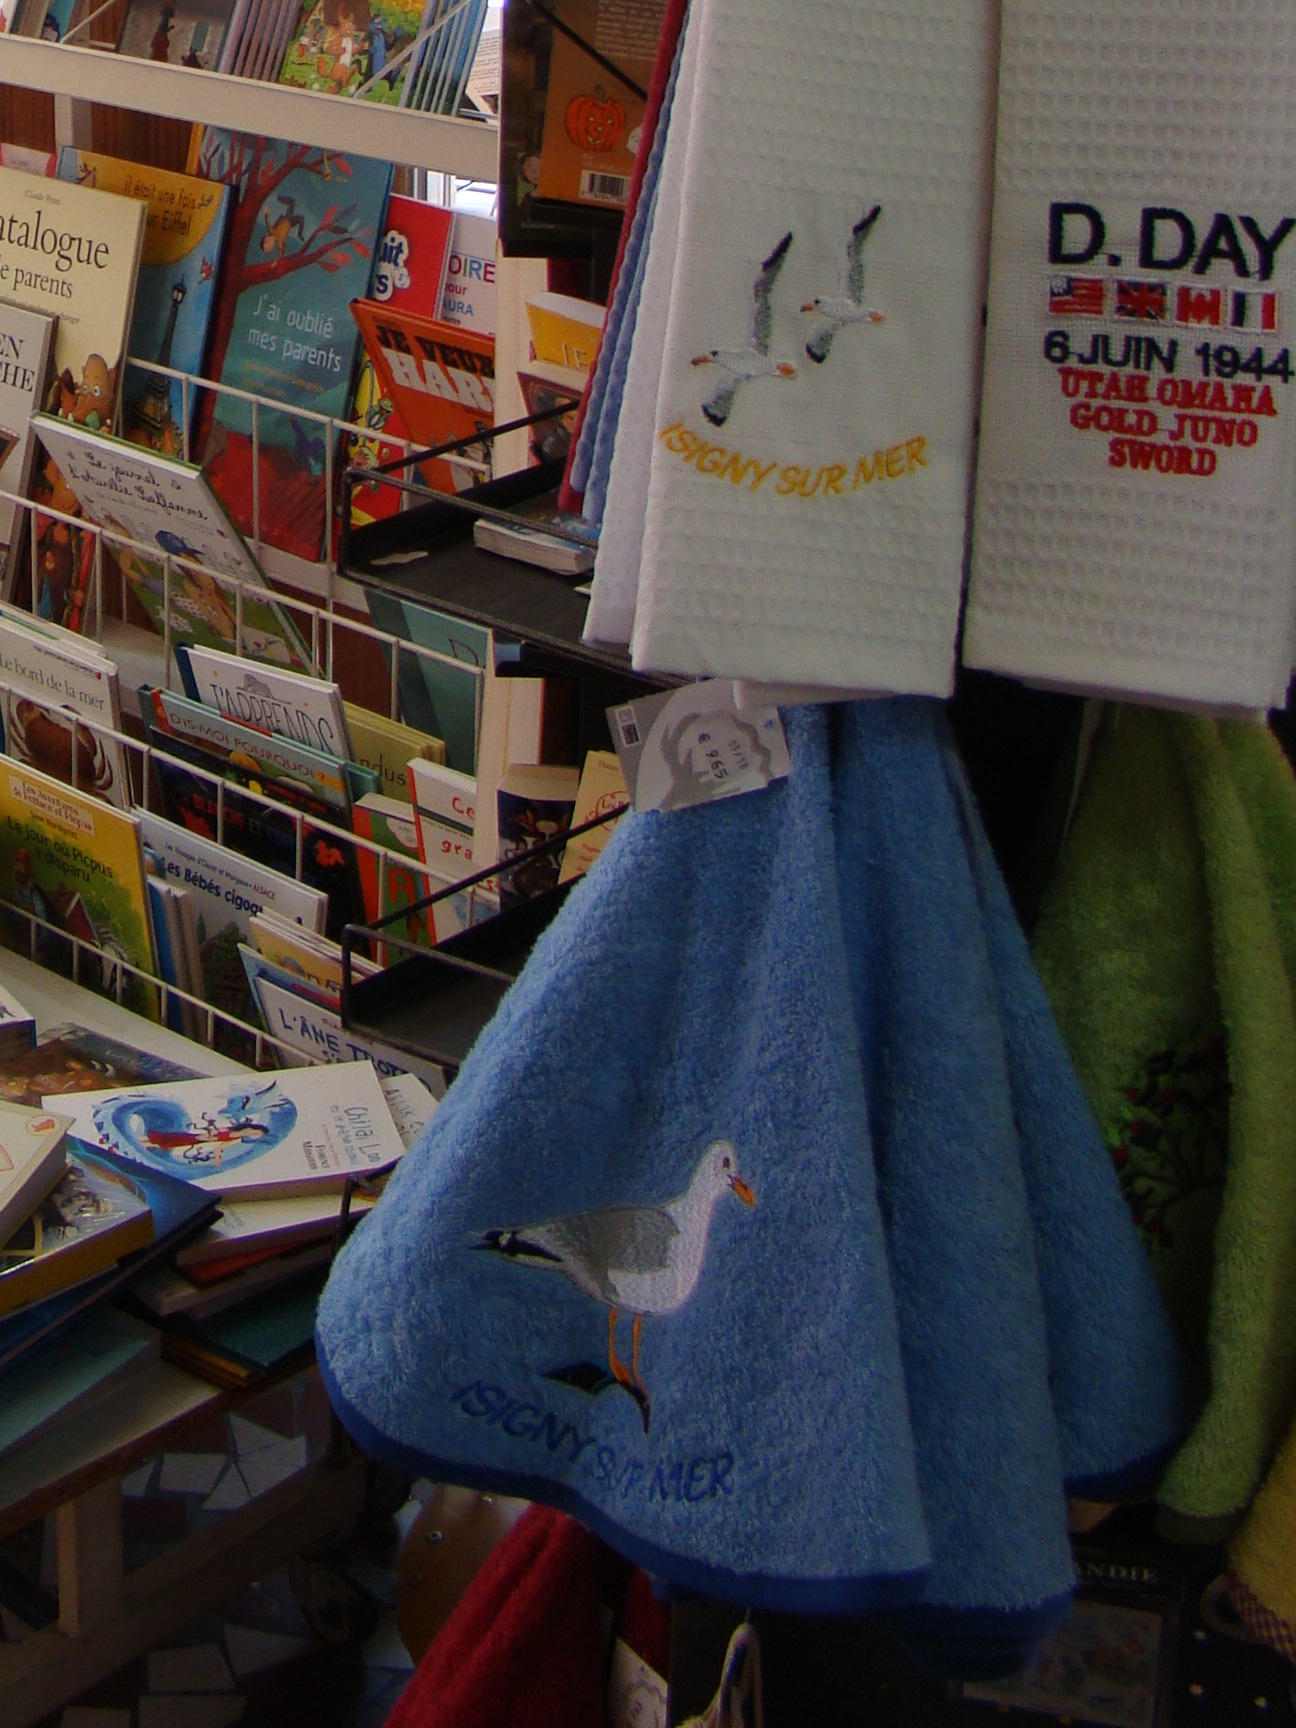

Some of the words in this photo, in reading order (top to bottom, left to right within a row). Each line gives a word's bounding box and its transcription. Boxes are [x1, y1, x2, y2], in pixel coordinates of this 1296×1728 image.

[131, 183, 156, 202] était
[157, 191, 175, 205] une
[177, 194, 196, 211] fois
[160, 208, 192, 237] Eiffel
[12, 265, 74, 300] parents
[253, 294, 281, 322] J'ai
[286, 308, 334, 340] oublié
[247, 330, 278, 352] mes
[282, 336, 343, 373] parents
[1042, 329, 1070, 364] 6
[1071, 332, 1178, 374] JUIN
[1194, 341, 1296, 383] 1944
[1059, 366, 1148, 402] UTAH
[1154, 375, 1278, 418] OMAHA
[1069, 402, 1162, 438] GOLD
[1167, 412, 1259, 448] JUNO
[656, 420, 775, 493] ISIGNY
[779, 464, 848, 498] SUR
[850, 434, 931, 486] MER
[1107, 436, 1218, 478] SWORD
[15, 662, 45, 686] bord
[46, 673, 63, 691] de
[65, 681, 77, 699] la
[79, 691, 105, 710] mer
[169, 711, 231, 747] DIS-MOI
[234, 736, 316, 780] POURQUOI
[6, 814, 23, 832] Le
[23, 823, 51, 847] jour
[52, 837, 70, 857] où
[70, 845, 114, 879] Picpus
[43, 851, 91, 884] disparu
[183, 861, 222, 896] Bébés
[277, 1006, 342, 1055] L'ÂNE
